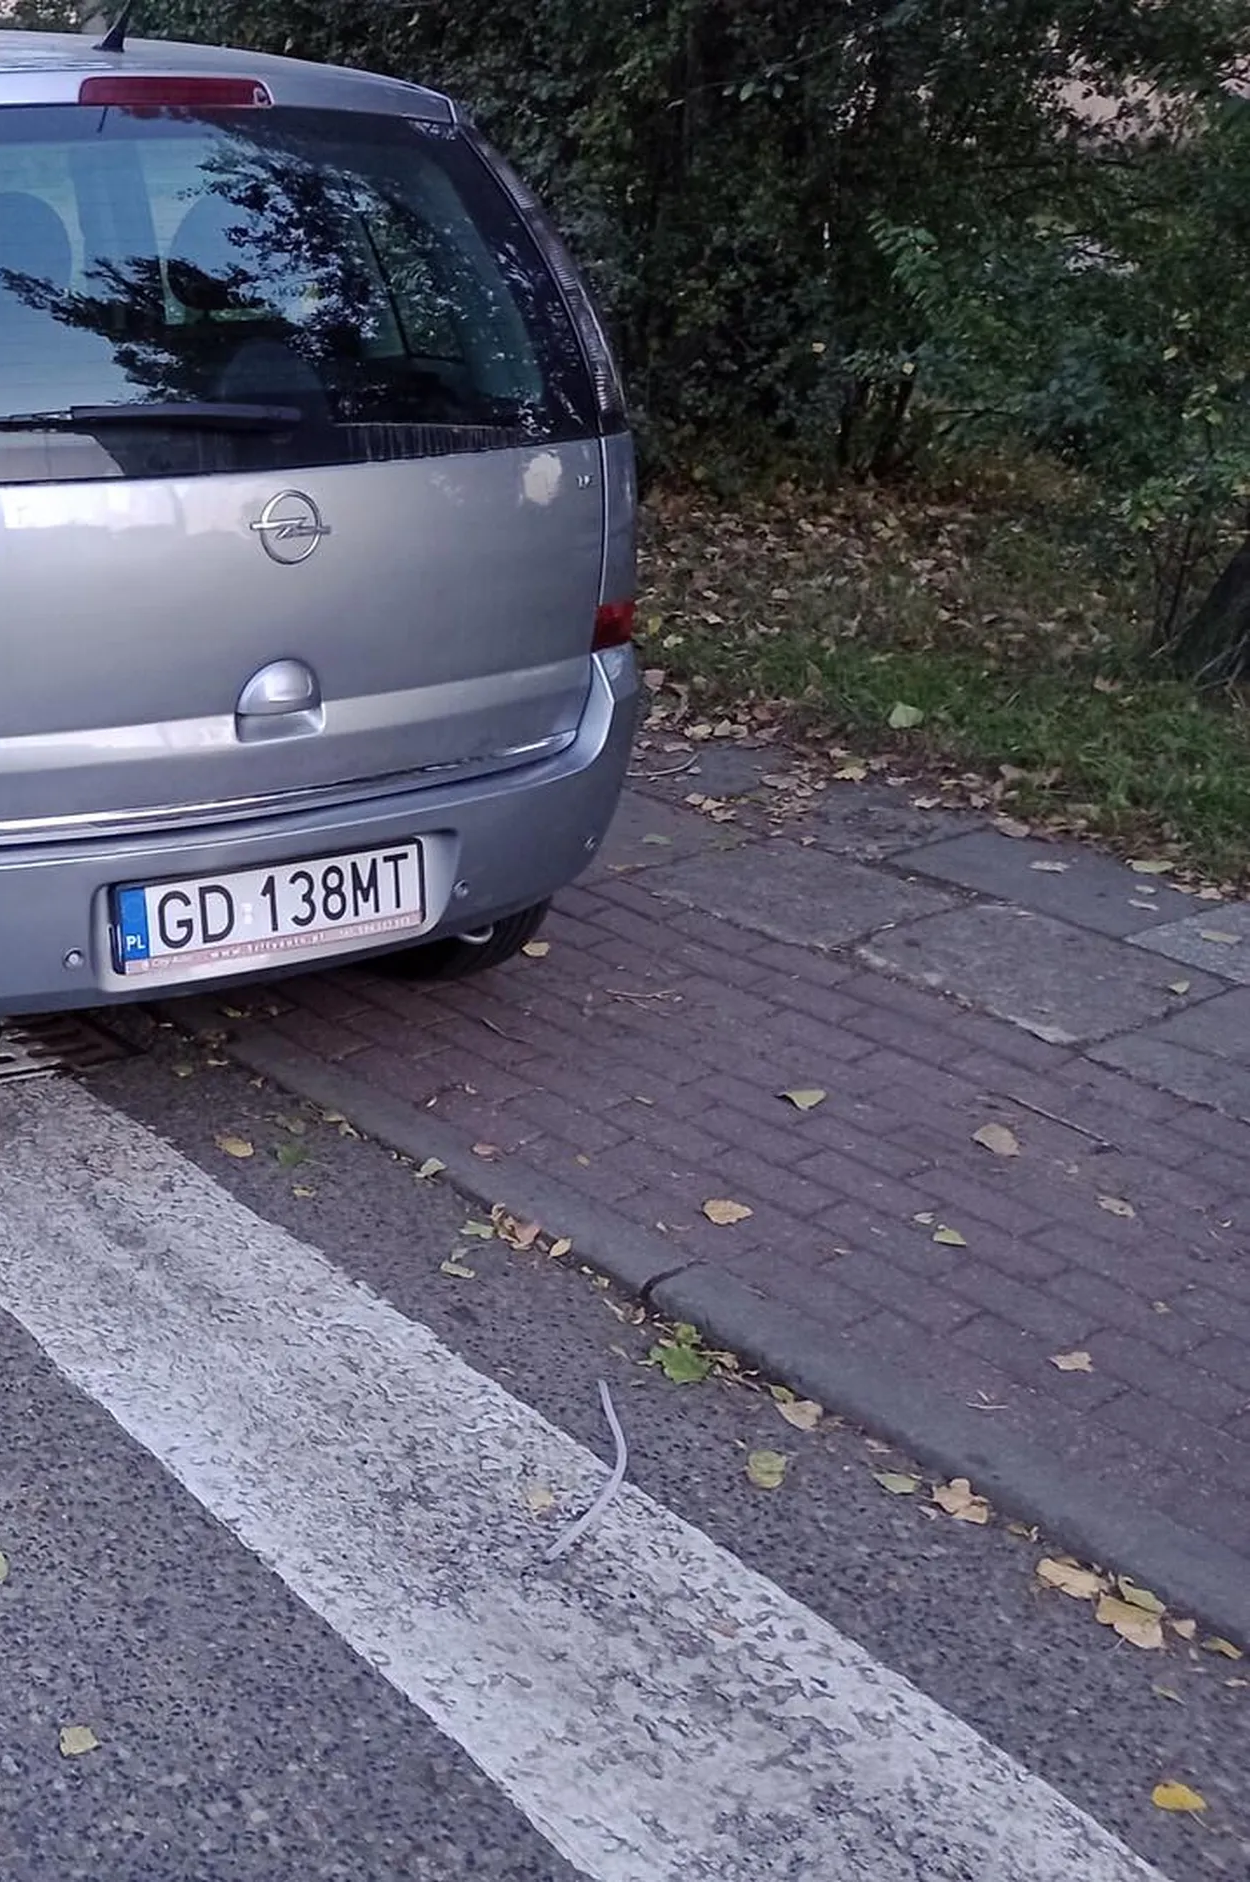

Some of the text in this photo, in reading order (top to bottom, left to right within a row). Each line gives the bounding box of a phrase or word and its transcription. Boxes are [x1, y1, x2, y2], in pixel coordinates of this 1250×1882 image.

[157, 853, 409, 950] GD 138MT
[126, 935, 146, 951] PL
